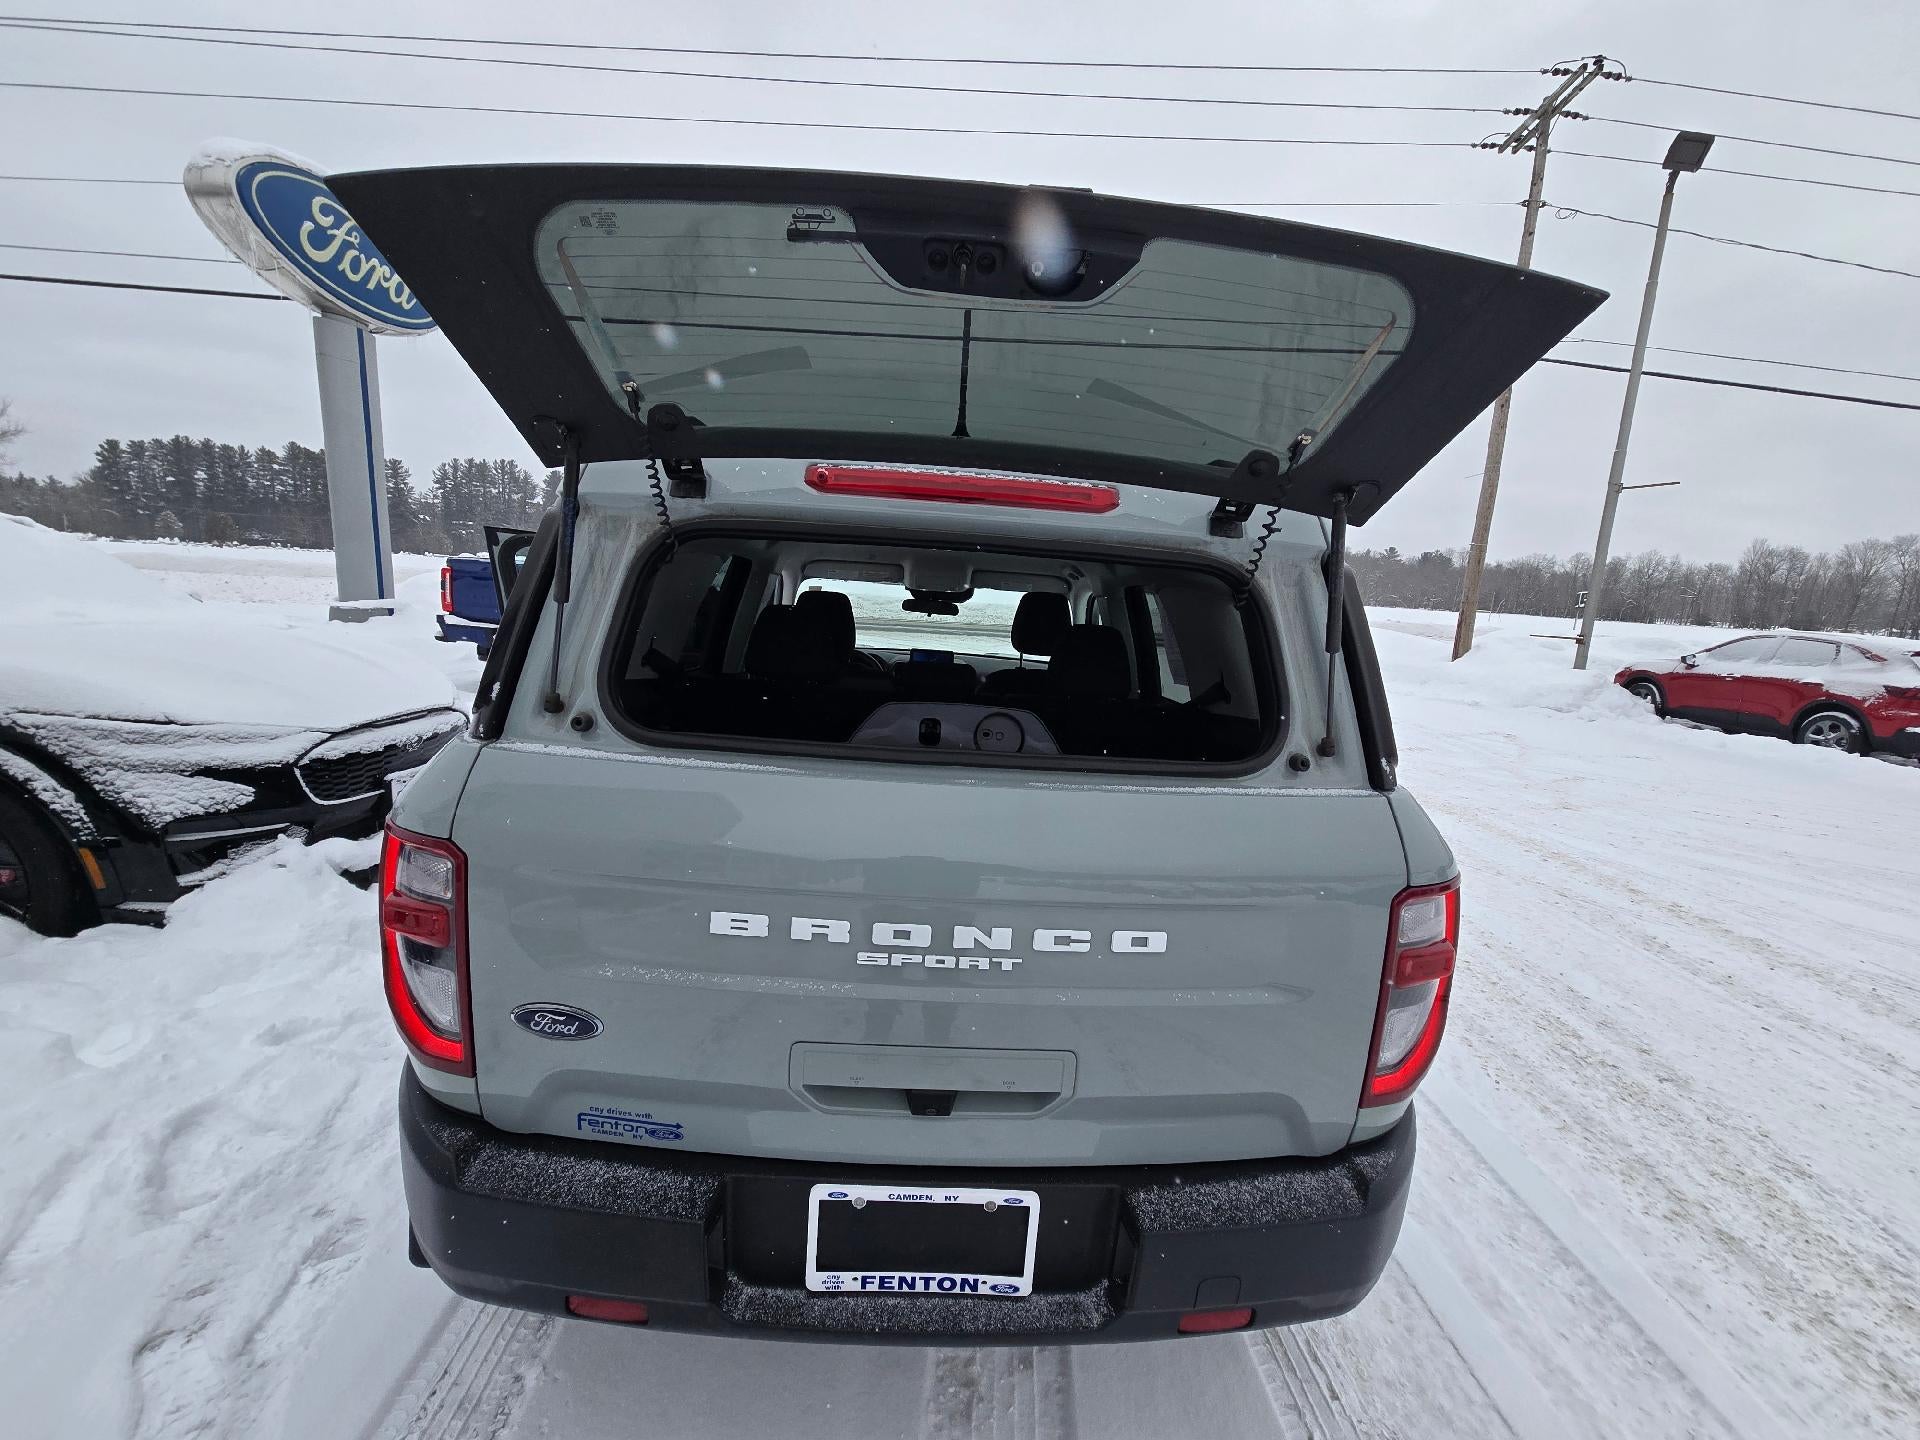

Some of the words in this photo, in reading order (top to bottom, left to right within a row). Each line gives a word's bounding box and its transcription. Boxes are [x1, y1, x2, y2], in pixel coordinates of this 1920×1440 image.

[709, 911, 1168, 953] BRONCO
[856, 951, 1023, 971] SPORT
[530, 1012, 579, 1035] Ford
[589, 1106, 604, 1114] cny
[606, 1107, 633, 1117] drives
[634, 1112, 653, 1120] with
[591, 1128, 624, 1137] CAMDEN
[860, 1275, 980, 1293] FENTON
